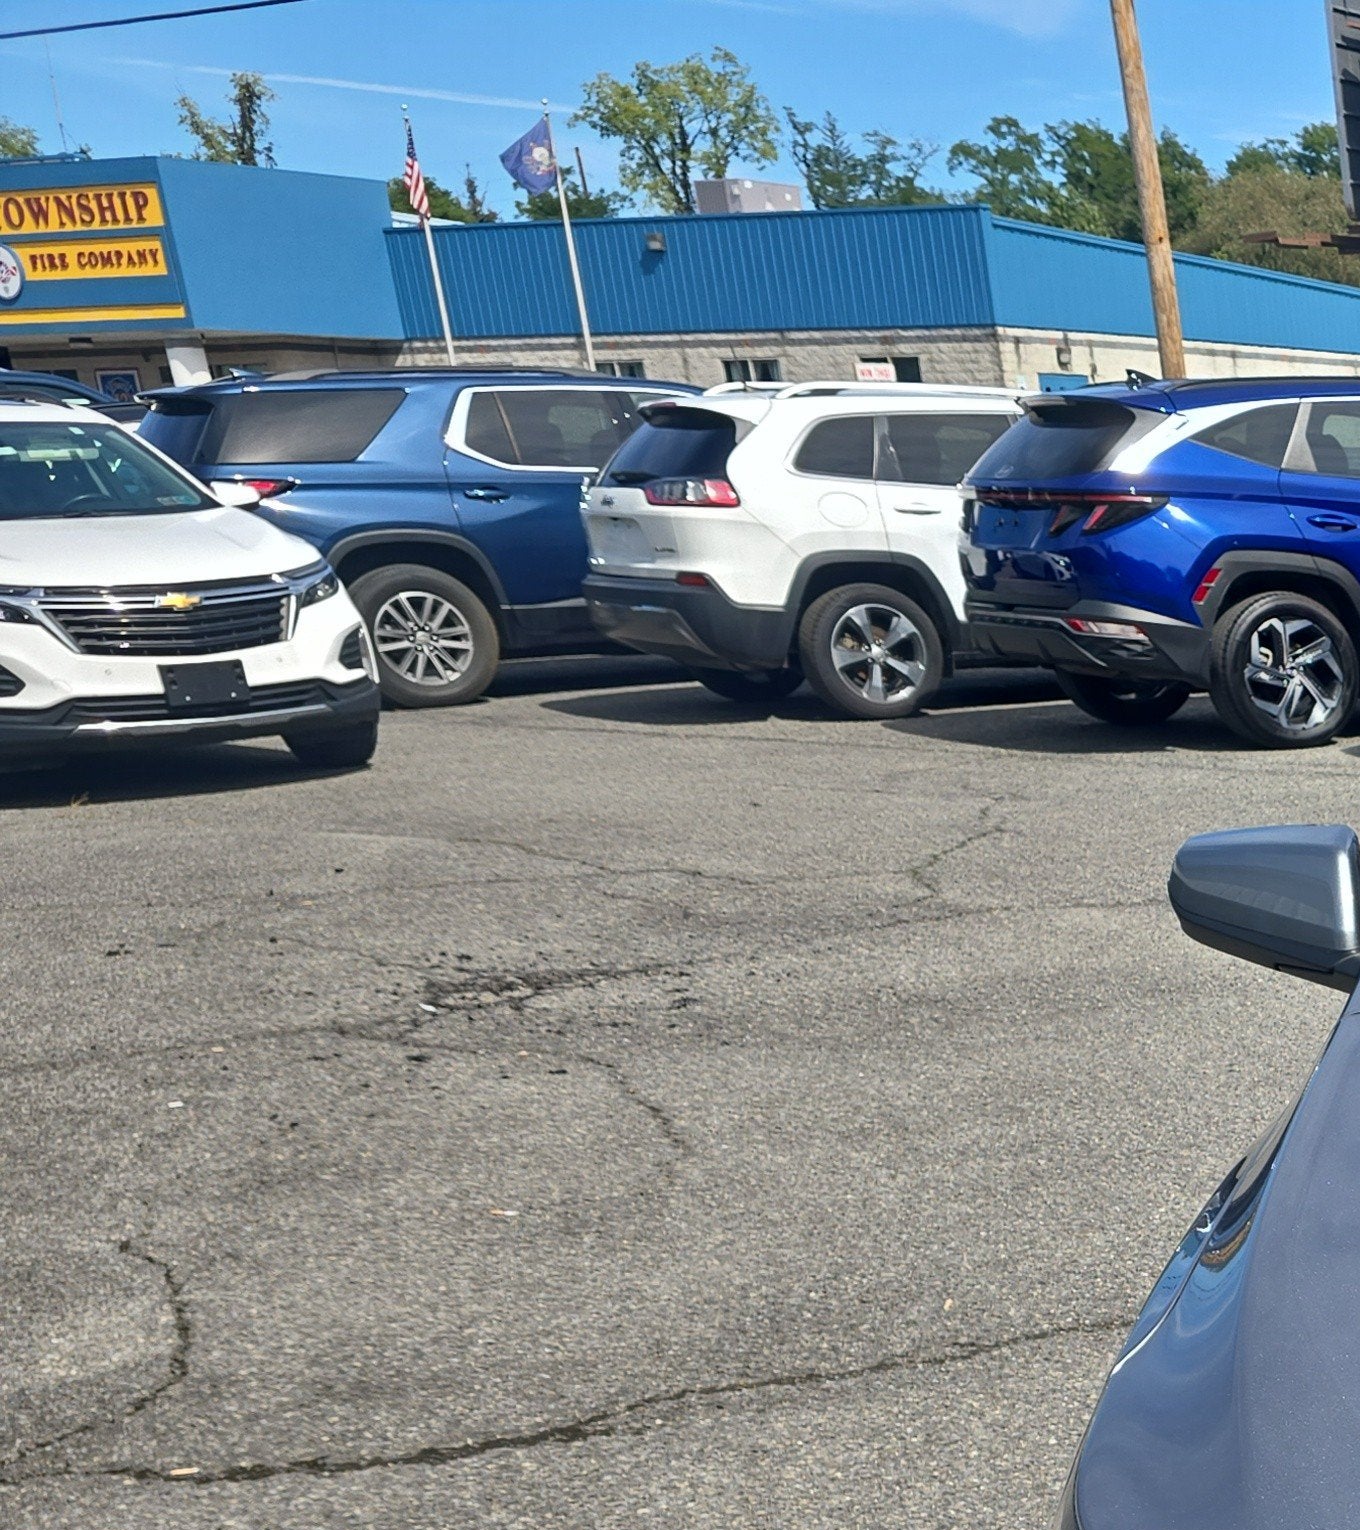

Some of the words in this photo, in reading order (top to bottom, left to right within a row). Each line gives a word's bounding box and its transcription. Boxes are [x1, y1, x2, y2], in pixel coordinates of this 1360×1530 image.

[0, 190, 149, 231] OWNSHIP
[29, 252, 70, 272] FIRE
[76, 248, 159, 270] COMPANY
